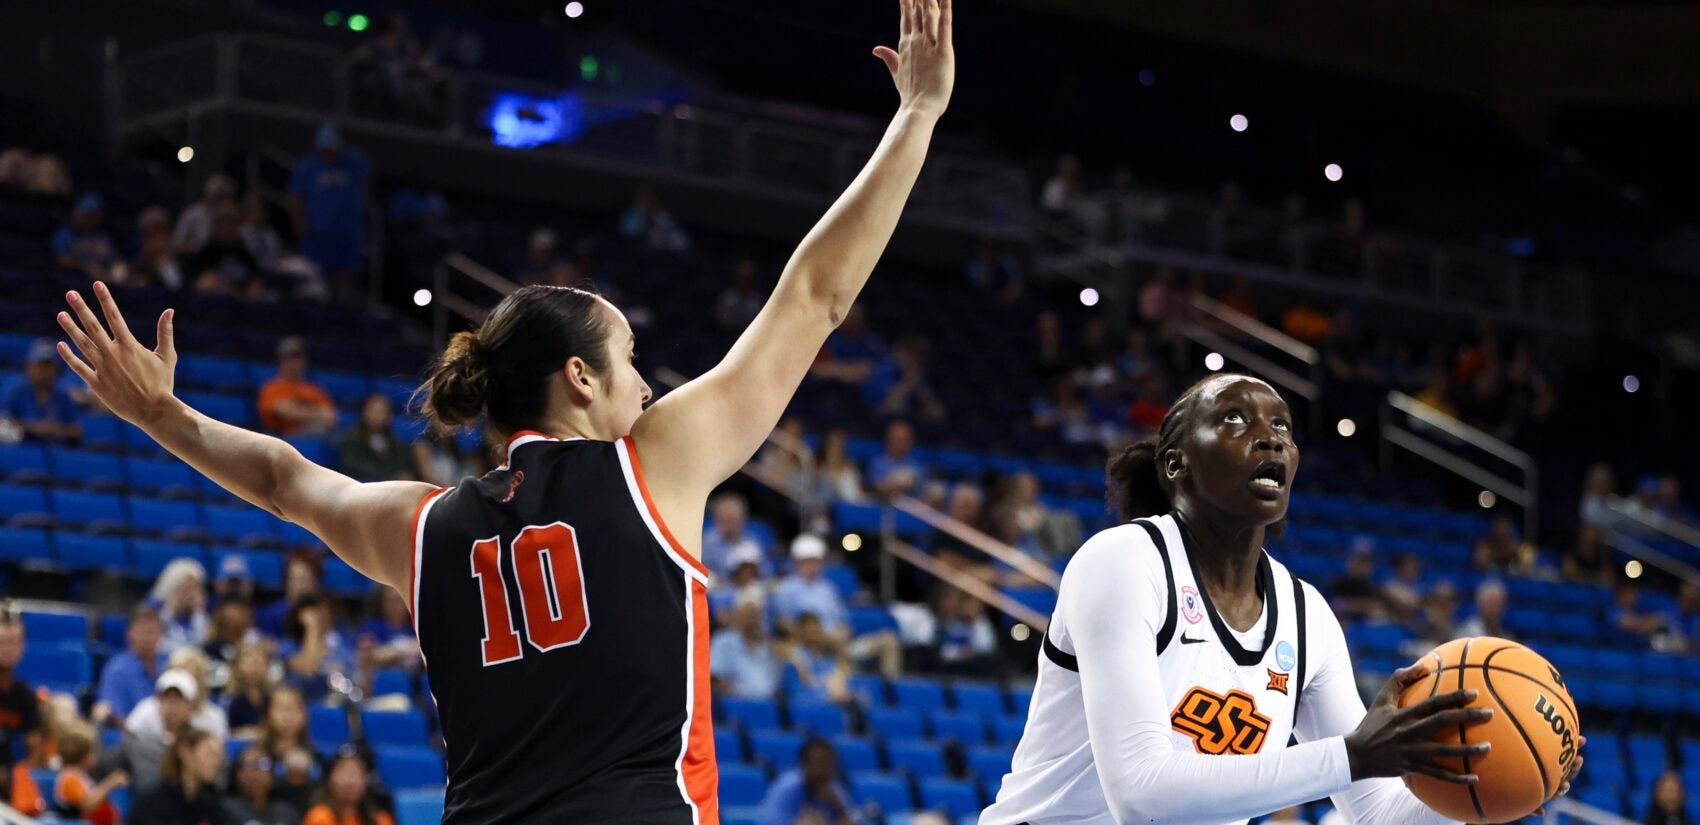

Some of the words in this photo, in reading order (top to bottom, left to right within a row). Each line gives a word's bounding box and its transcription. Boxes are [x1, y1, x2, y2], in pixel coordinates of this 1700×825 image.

[471, 521, 591, 667] 10
[1171, 686, 1272, 755] OSU
[1266, 668, 1289, 696] XII
[1534, 693, 1576, 780] ilson
